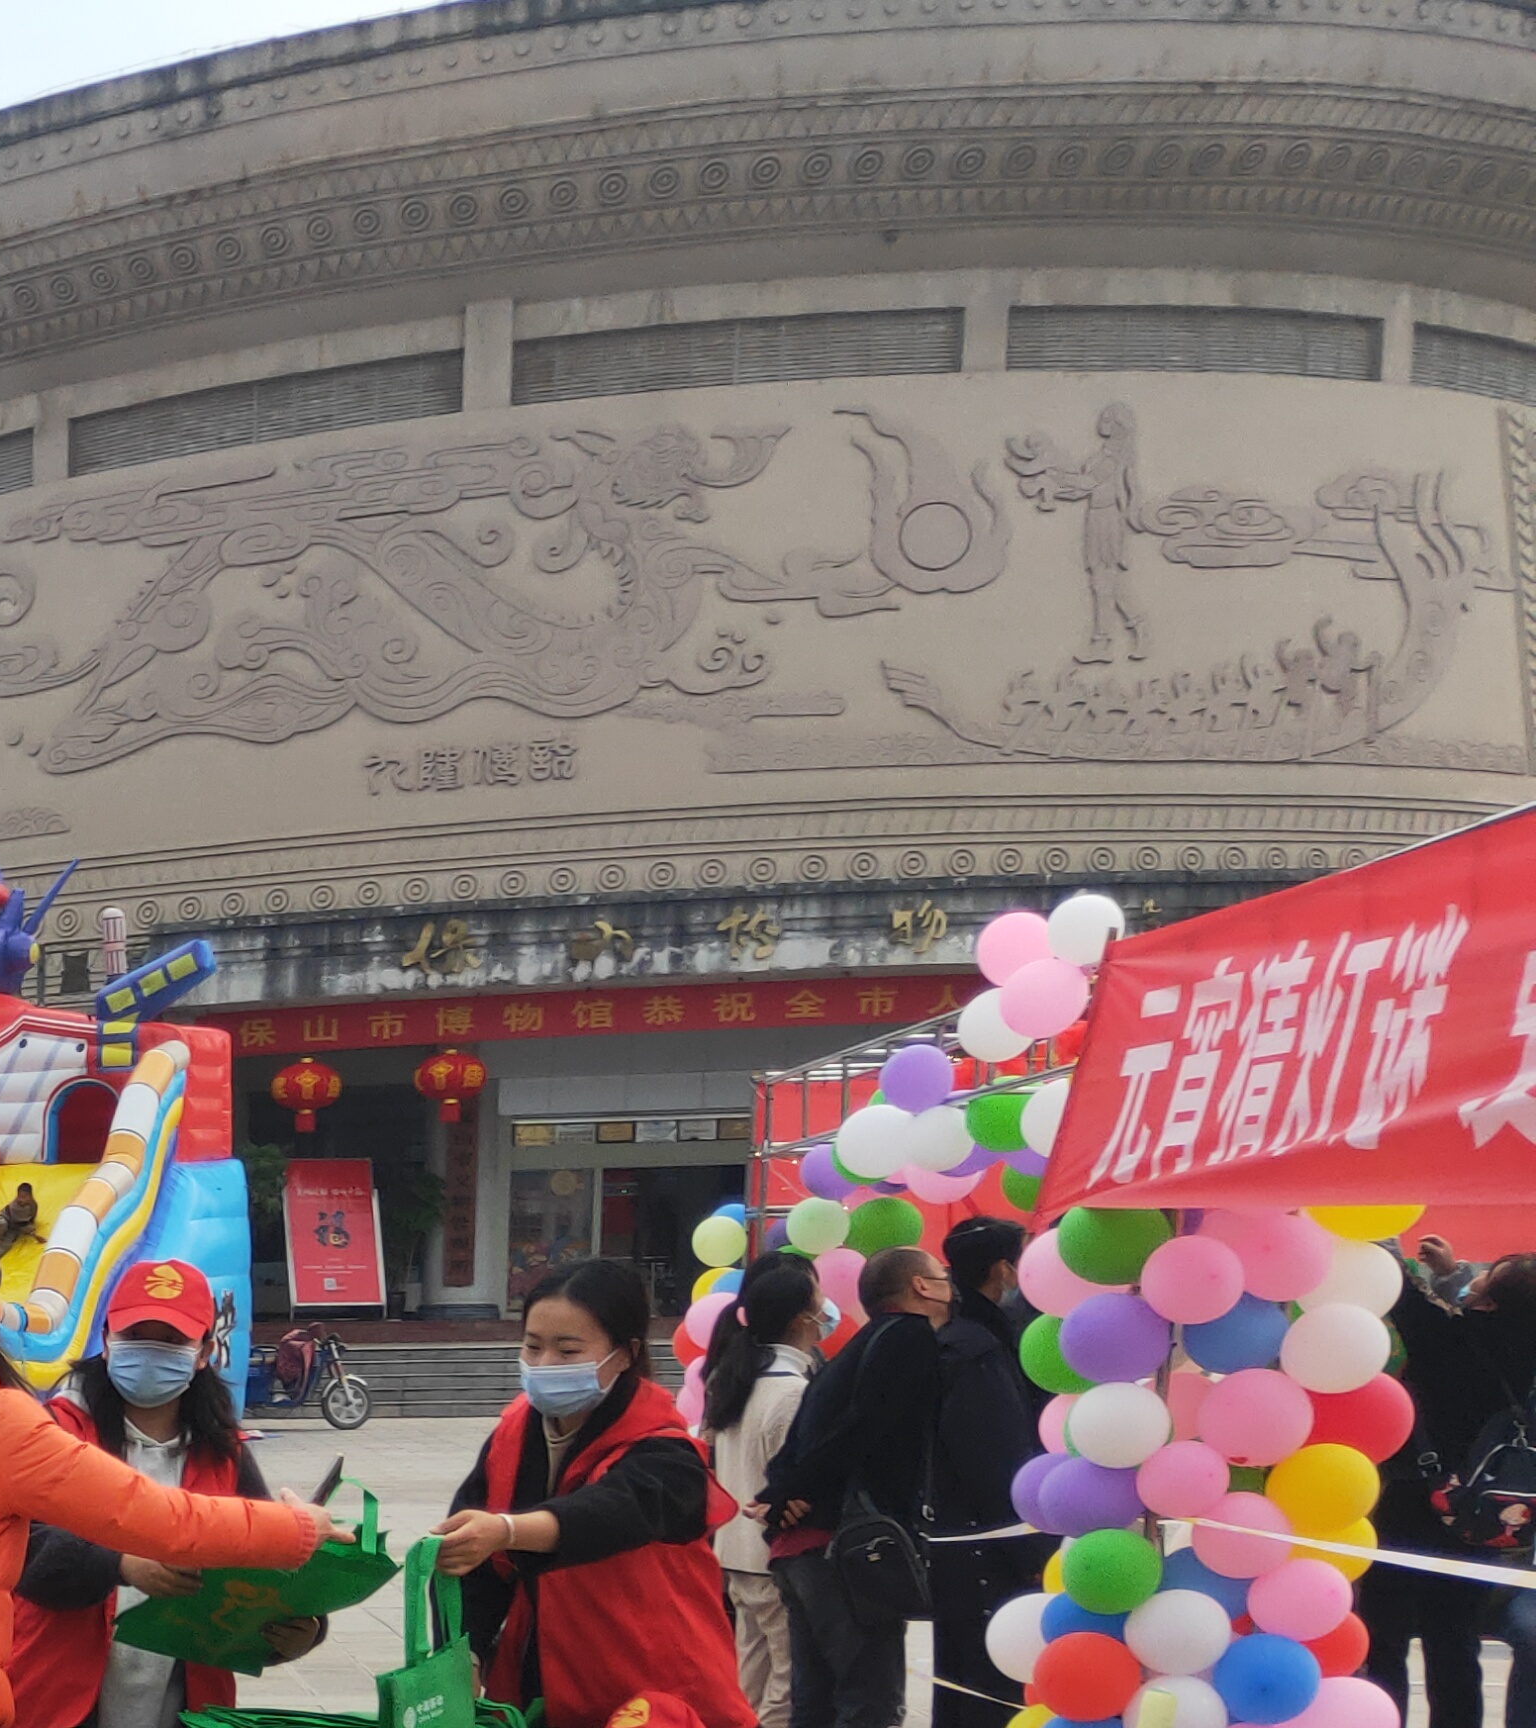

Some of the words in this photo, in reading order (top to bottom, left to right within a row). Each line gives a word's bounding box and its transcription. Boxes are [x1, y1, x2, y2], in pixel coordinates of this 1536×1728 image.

[1086, 904, 1470, 1189] 元宵猜灯谜
